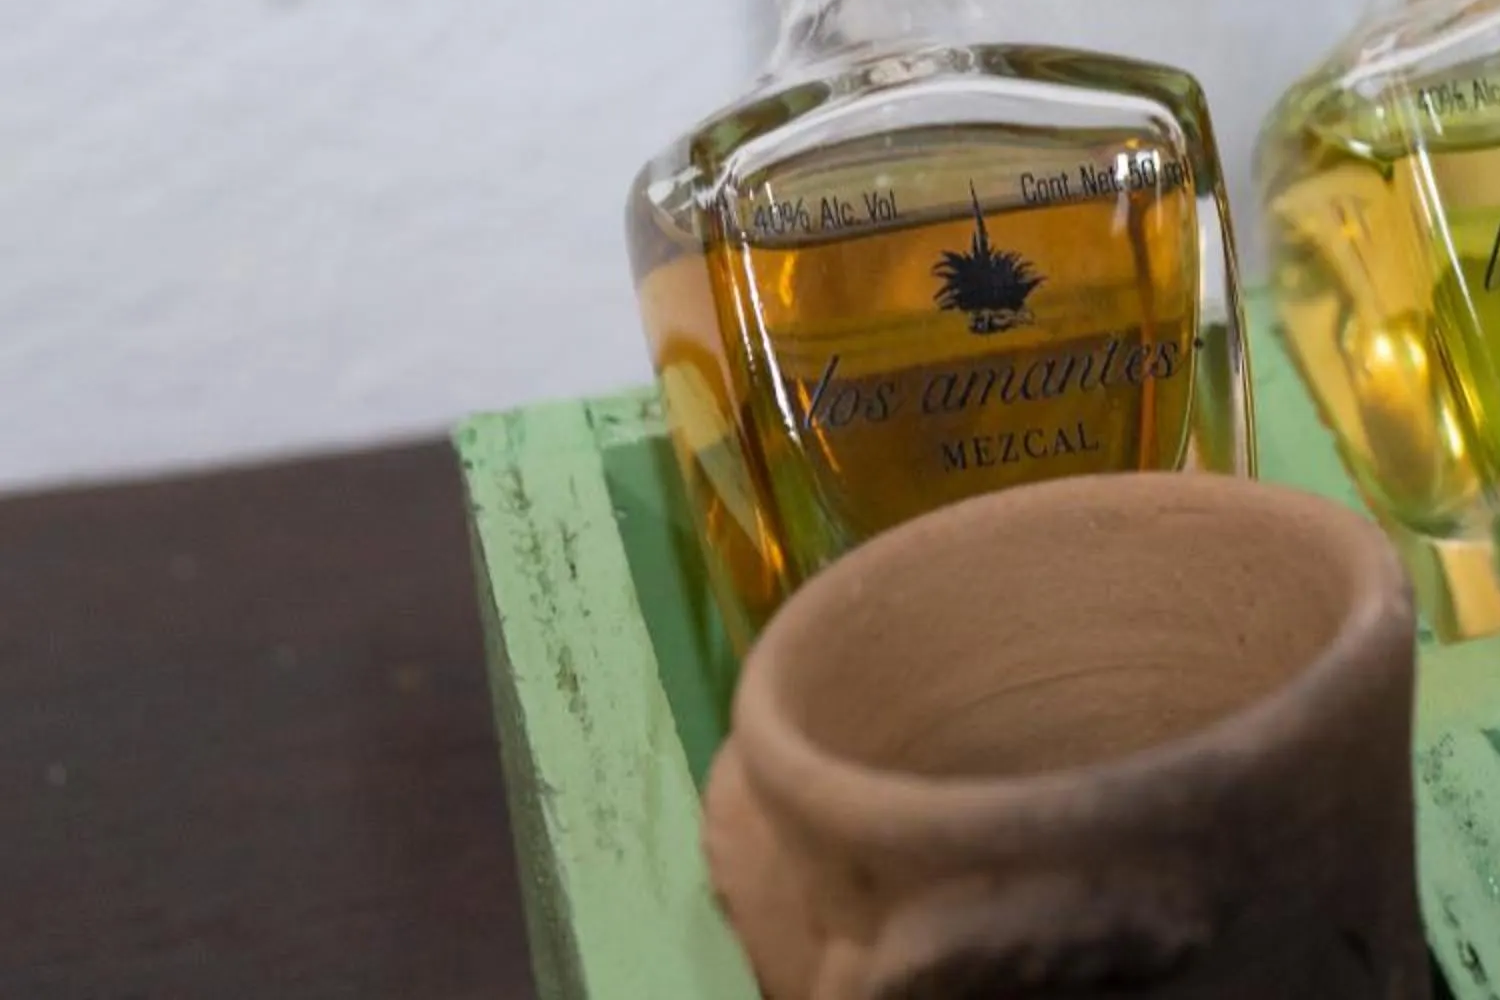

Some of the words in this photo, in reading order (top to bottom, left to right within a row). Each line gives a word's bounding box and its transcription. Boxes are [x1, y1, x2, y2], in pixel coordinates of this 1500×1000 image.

[803, 353, 896, 431] los
[920, 337, 1180, 415] amantes
[940, 421, 1100, 474] MEZCAL
